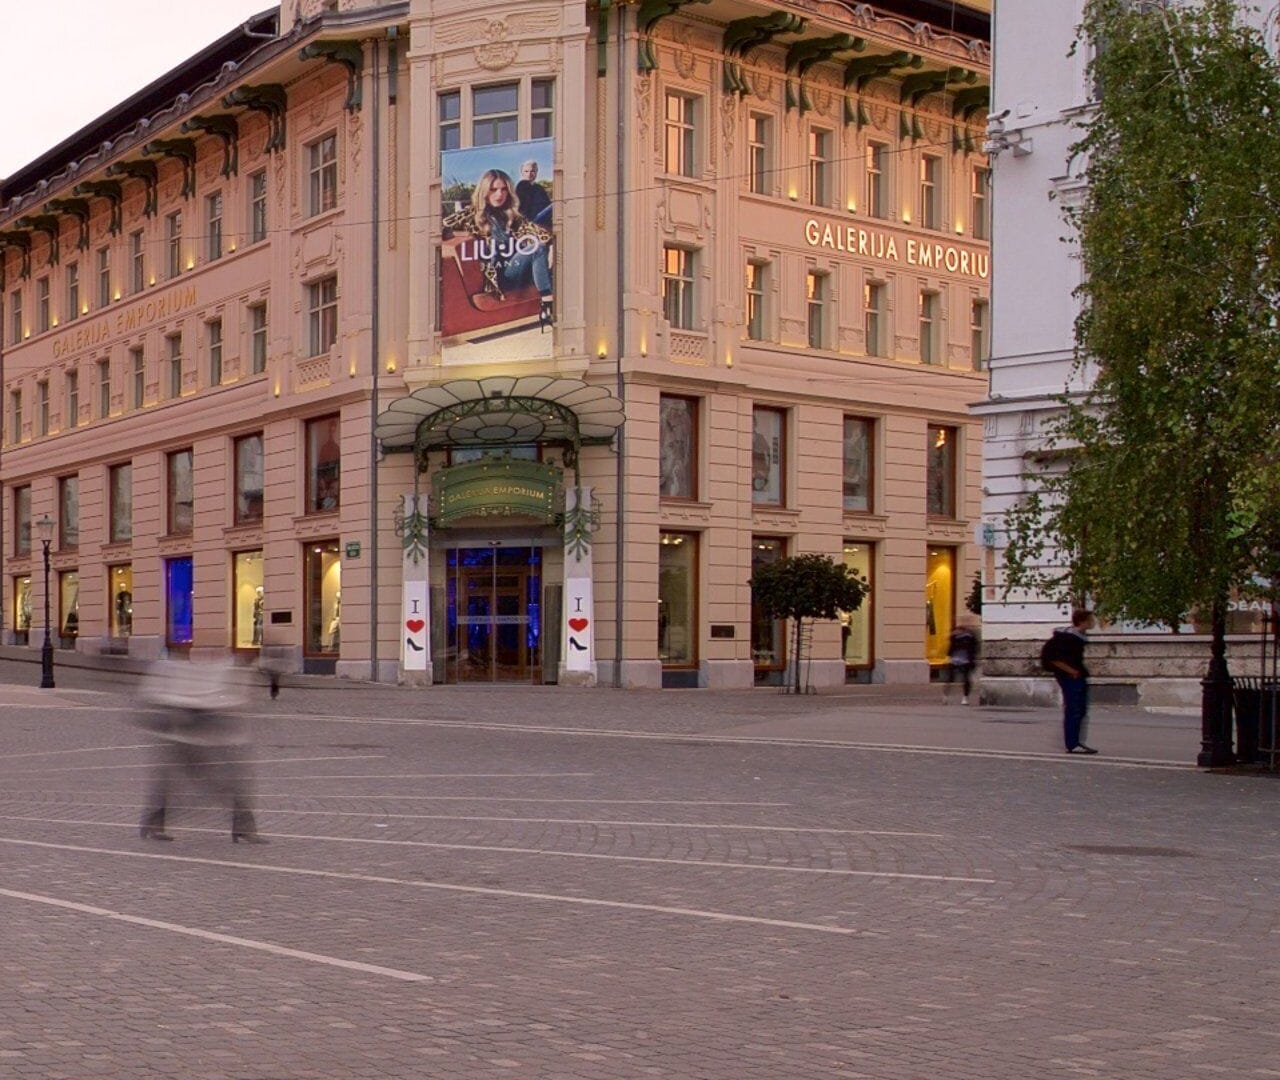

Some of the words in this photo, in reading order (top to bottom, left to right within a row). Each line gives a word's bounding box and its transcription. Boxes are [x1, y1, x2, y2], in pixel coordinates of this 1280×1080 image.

[805, 219, 899, 261] GALERIJA
[52, 321, 110, 358] GALERIJA
[116, 287, 197, 334] EMPORIUM
[493, 486, 544, 500] EMPORIUM
